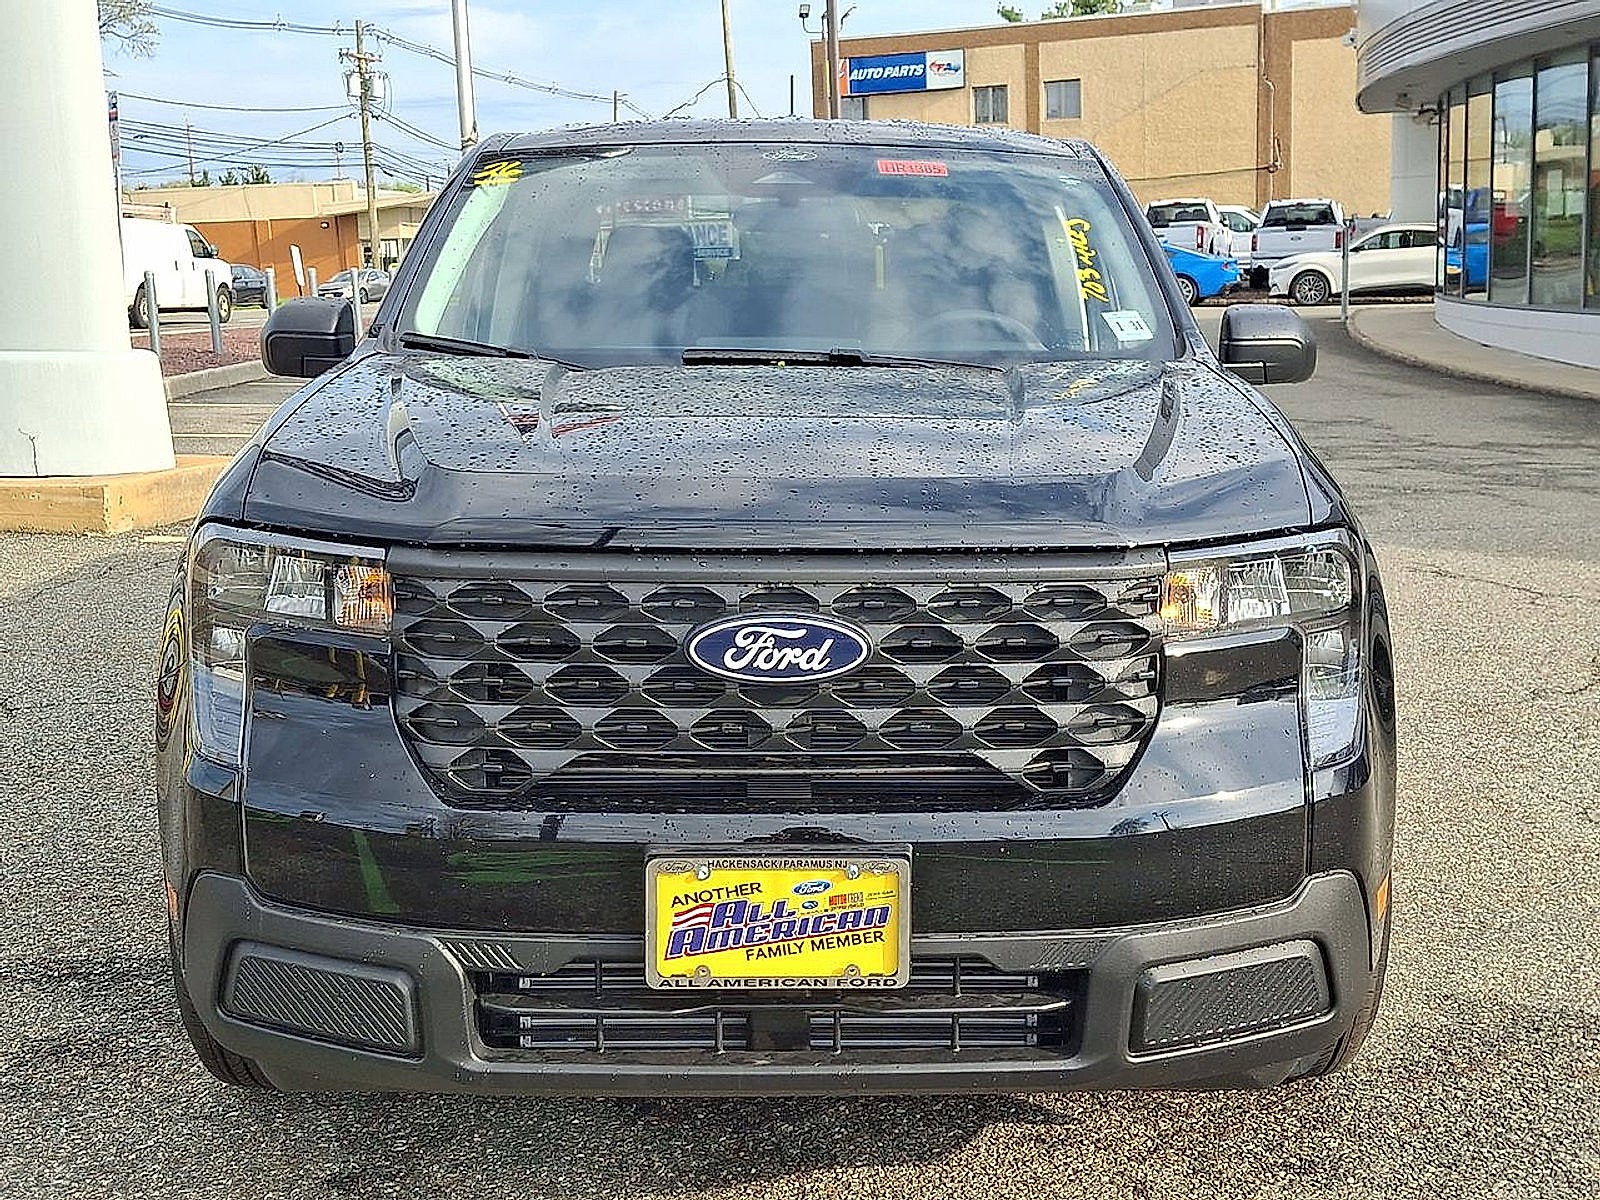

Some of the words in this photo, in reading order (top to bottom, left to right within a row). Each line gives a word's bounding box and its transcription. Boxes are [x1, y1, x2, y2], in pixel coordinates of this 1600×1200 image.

[850, 66, 883, 81] AUTO
[883, 63, 925, 79] PARTS
[723, 625, 835, 671] Ford
[834, 860, 848, 869] NJ
[671, 882, 763, 908] ANOTHER
[745, 941, 805, 961] FAMILY
[811, 930, 886, 952] MEMBER
[658, 979, 700, 988] ALL
[707, 979, 828, 988] AMERICAN
[836, 979, 898, 988] FORD
